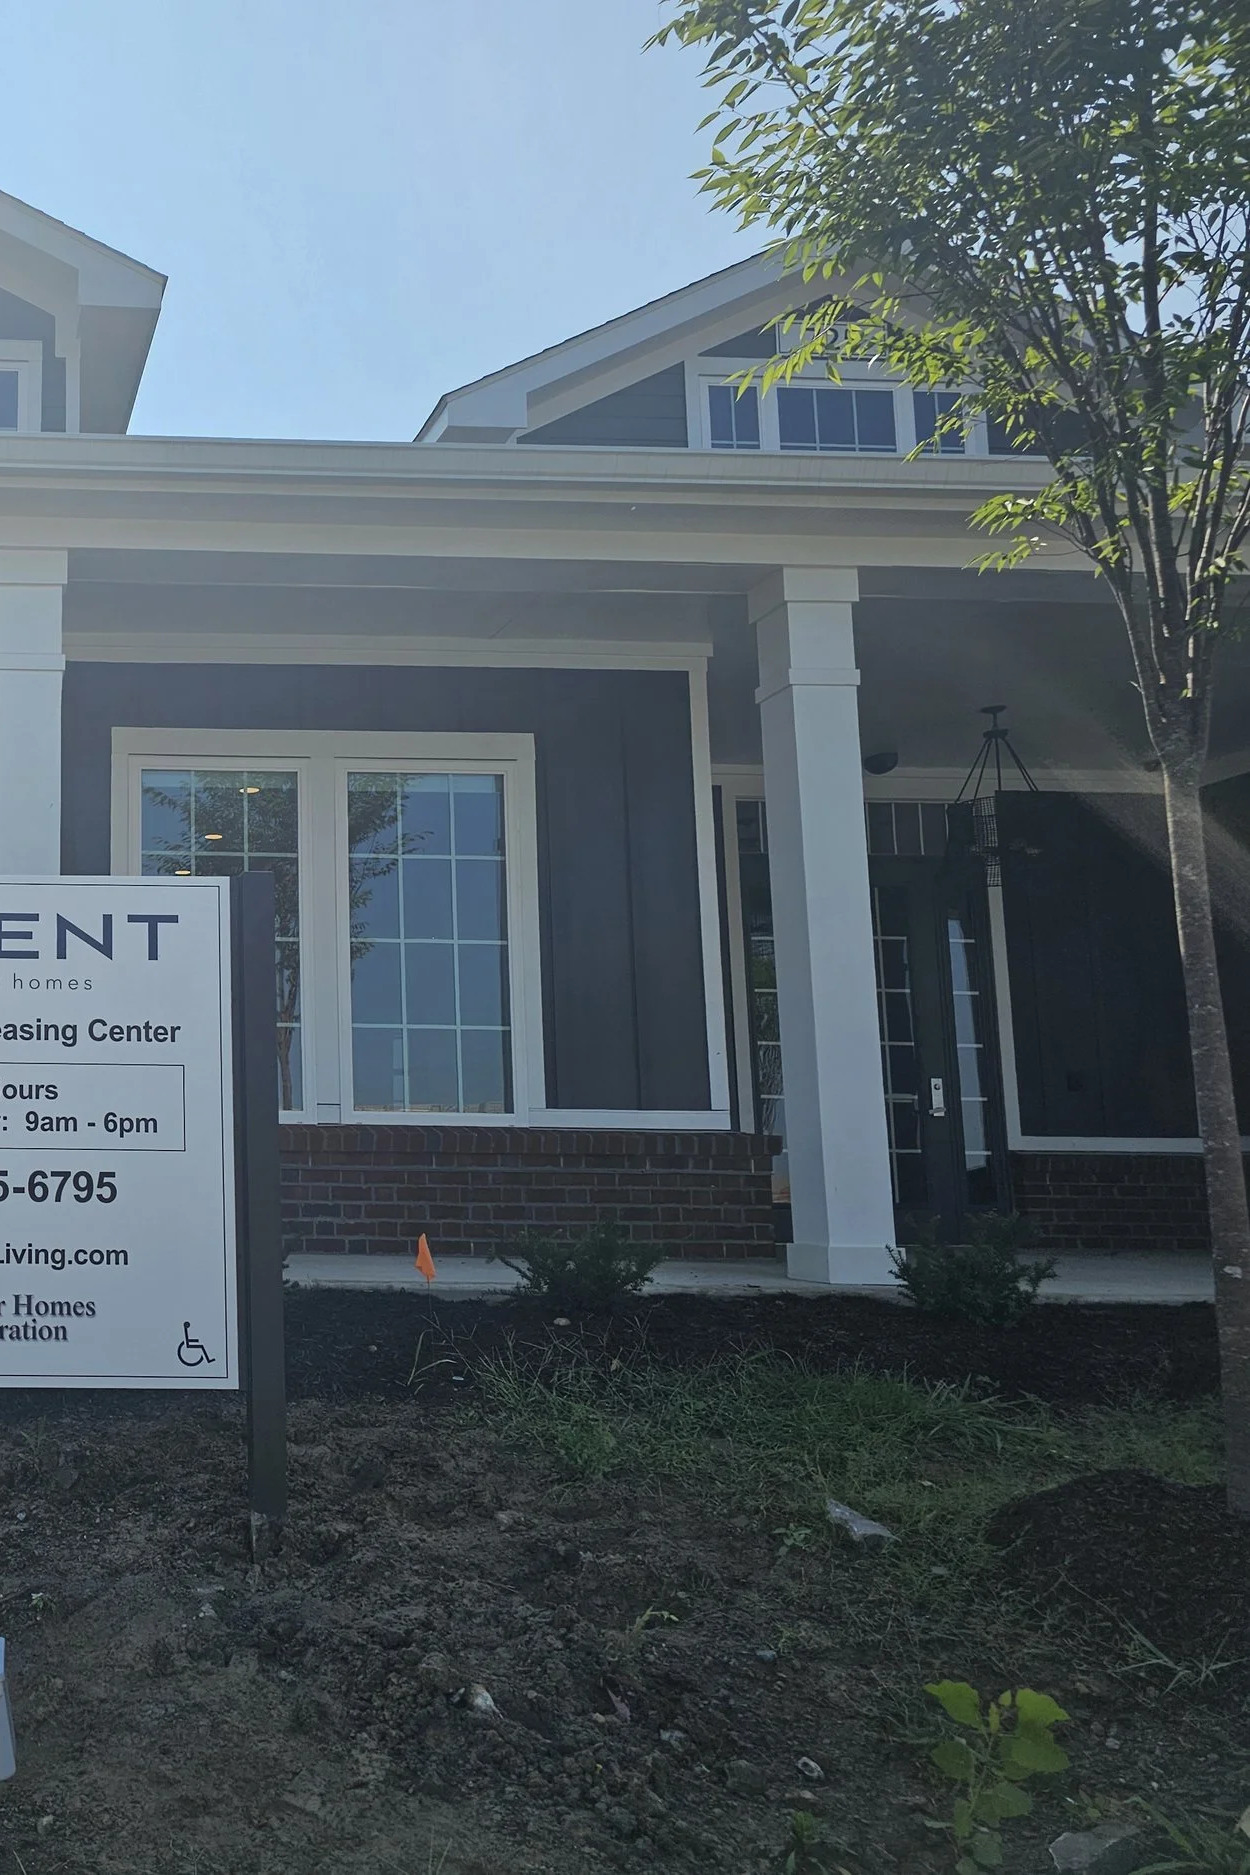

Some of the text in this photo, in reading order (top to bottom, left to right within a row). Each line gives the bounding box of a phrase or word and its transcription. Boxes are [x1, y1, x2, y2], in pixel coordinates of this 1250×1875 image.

[13, 972, 94, 991] homes
[87, 1018, 182, 1043] Center
[25, 1110, 78, 1132] 9am
[103, 1111, 158, 1139] 6pm
[13, 1294, 96, 1318] Homes
